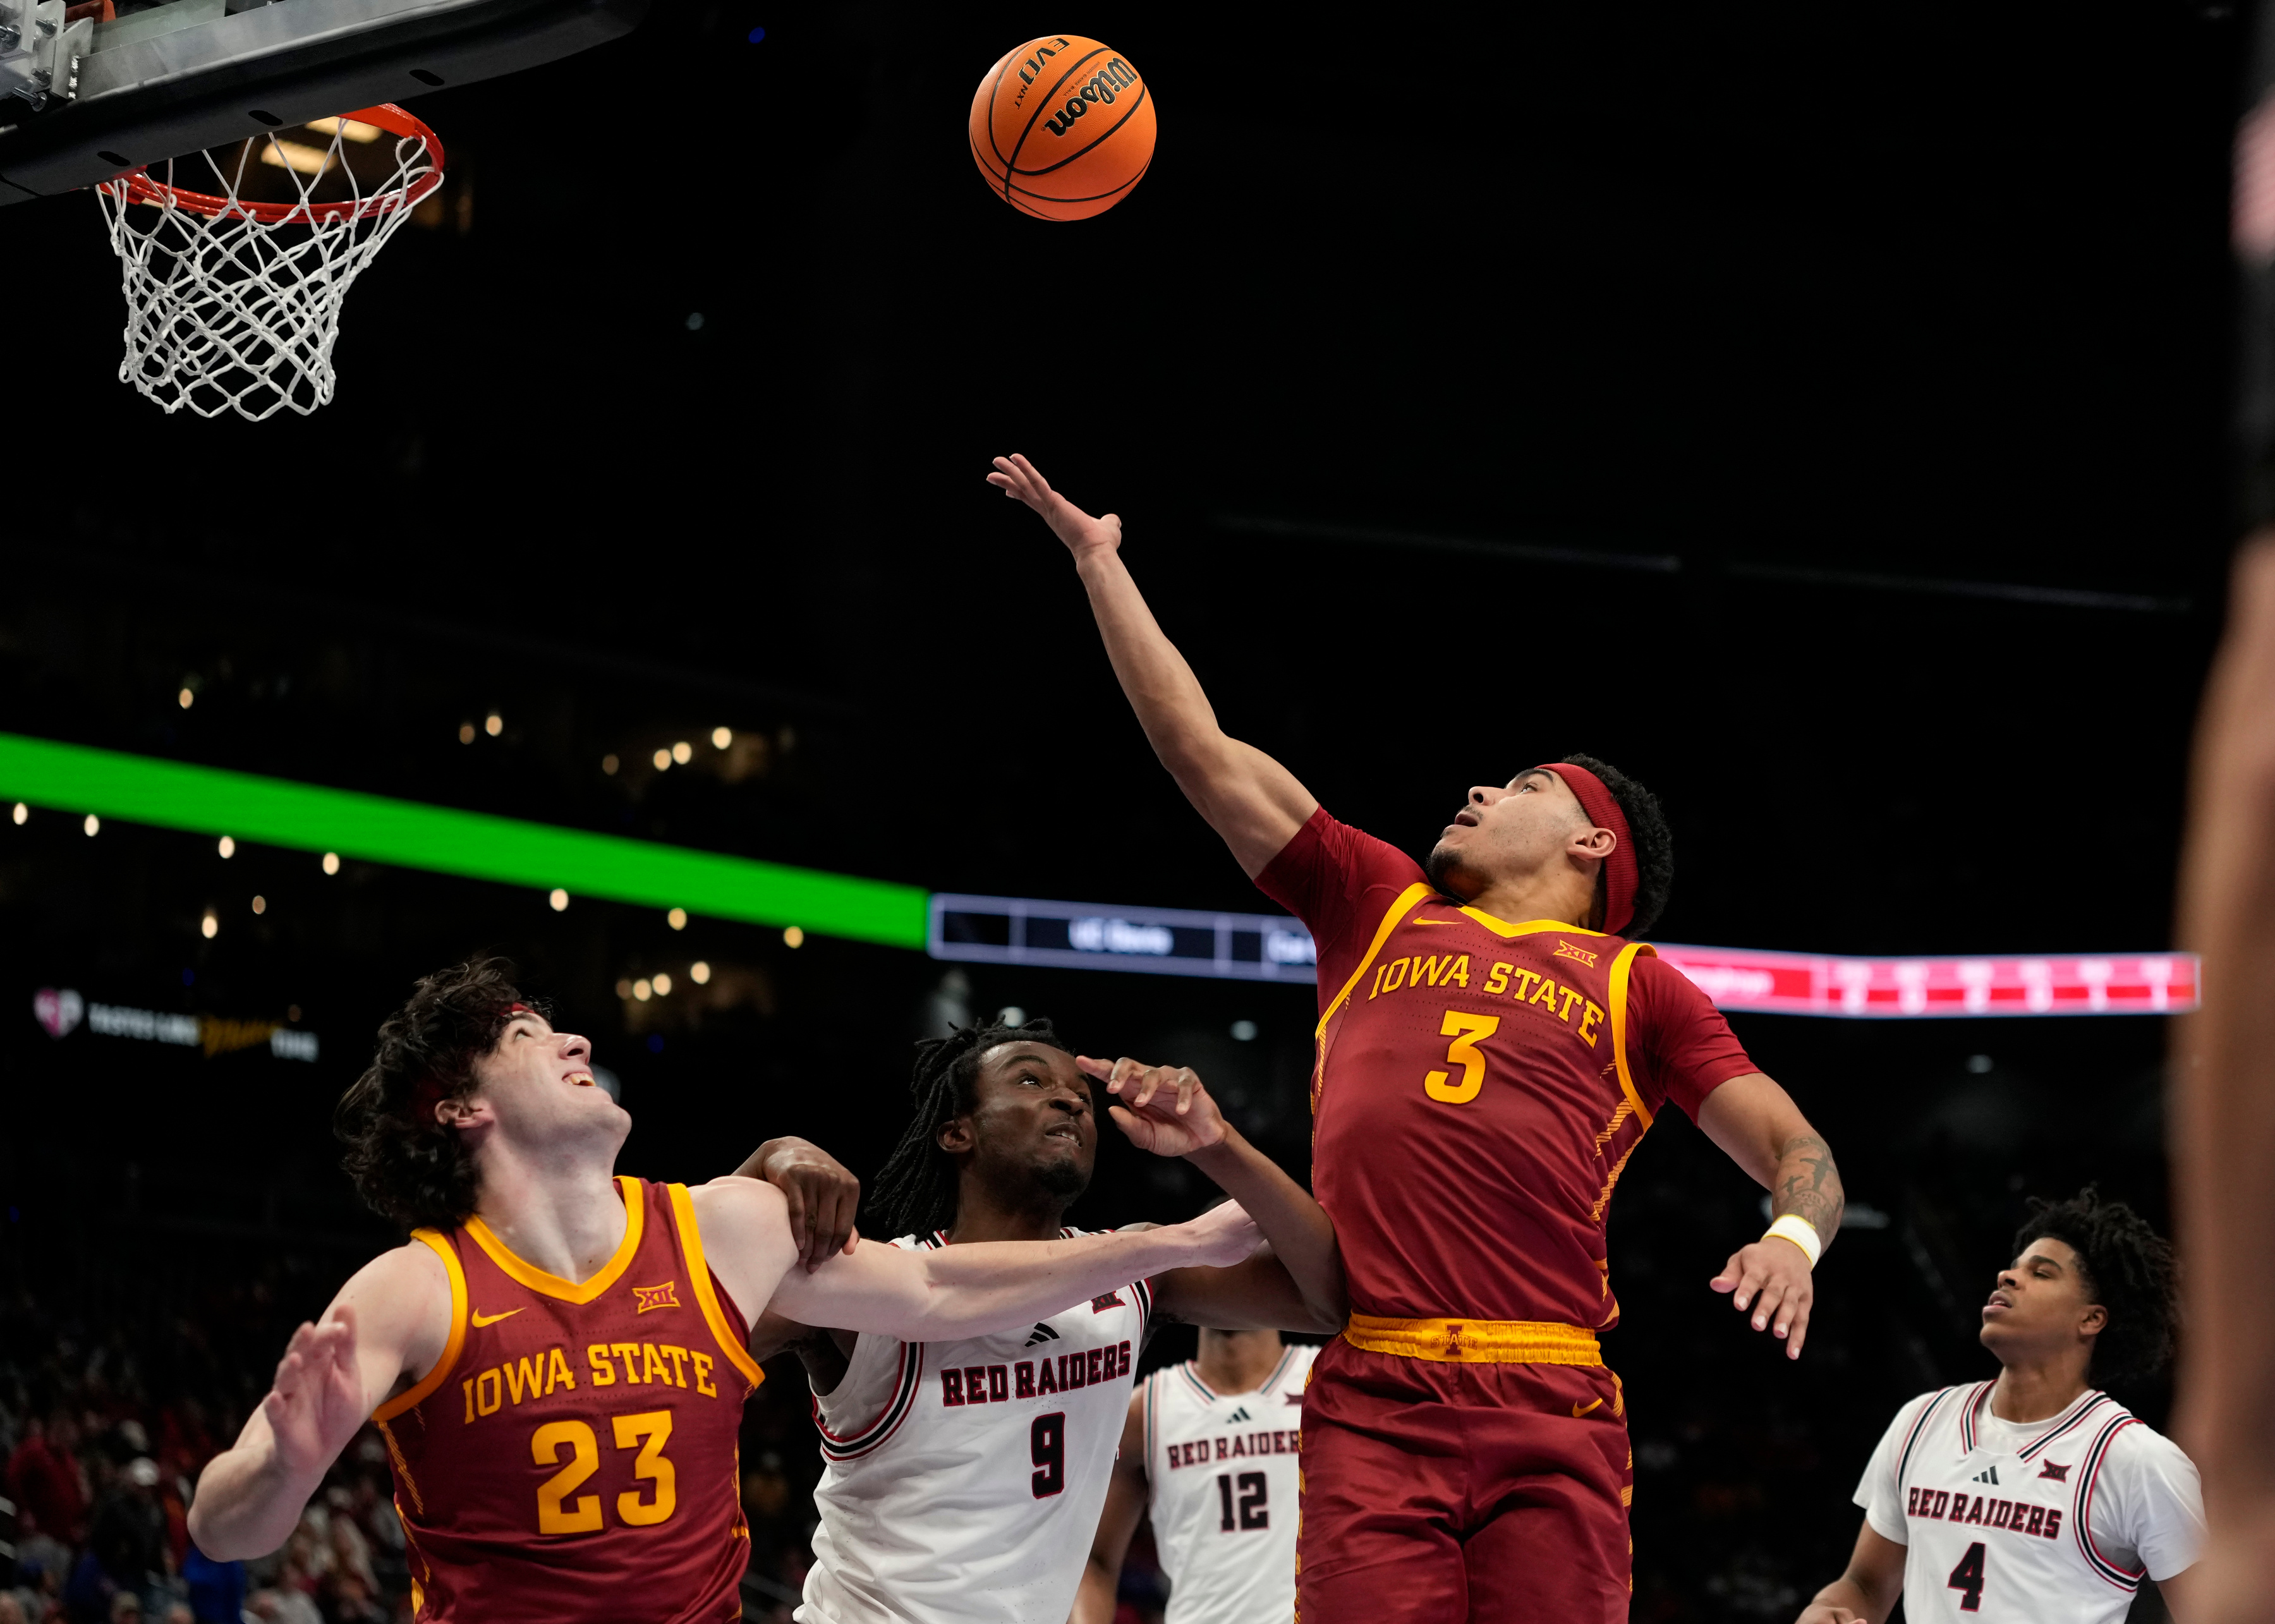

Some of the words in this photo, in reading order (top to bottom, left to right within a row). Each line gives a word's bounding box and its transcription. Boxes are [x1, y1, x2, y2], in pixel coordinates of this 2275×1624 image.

[1018, 38, 1070, 85] EVO
[1014, 84, 1028, 110] NXT
[1043, 57, 1138, 137] Wilson
[1367, 955, 1470, 1001] IOWA
[1483, 962, 1605, 1049] STATE
[1424, 1010, 1500, 1105] 3
[634, 1282, 679, 1312] XII
[462, 1348, 576, 1425] IOWA
[587, 1343, 717, 1398] STATE
[940, 1363, 1009, 1407] RED
[1014, 1340, 1131, 1400] RAIDERS
[531, 1410, 676, 1534] 23
[1031, 1411, 1065, 1499] 9
[1167, 1441, 1212, 1470] RED
[1215, 1430, 1299, 1462] RAIDER
[1217, 1470, 1269, 1532] 12
[1907, 1487, 1950, 1520] RED
[1948, 1493, 2063, 1540] RAIDERS
[1947, 1542, 1986, 1612] 4
